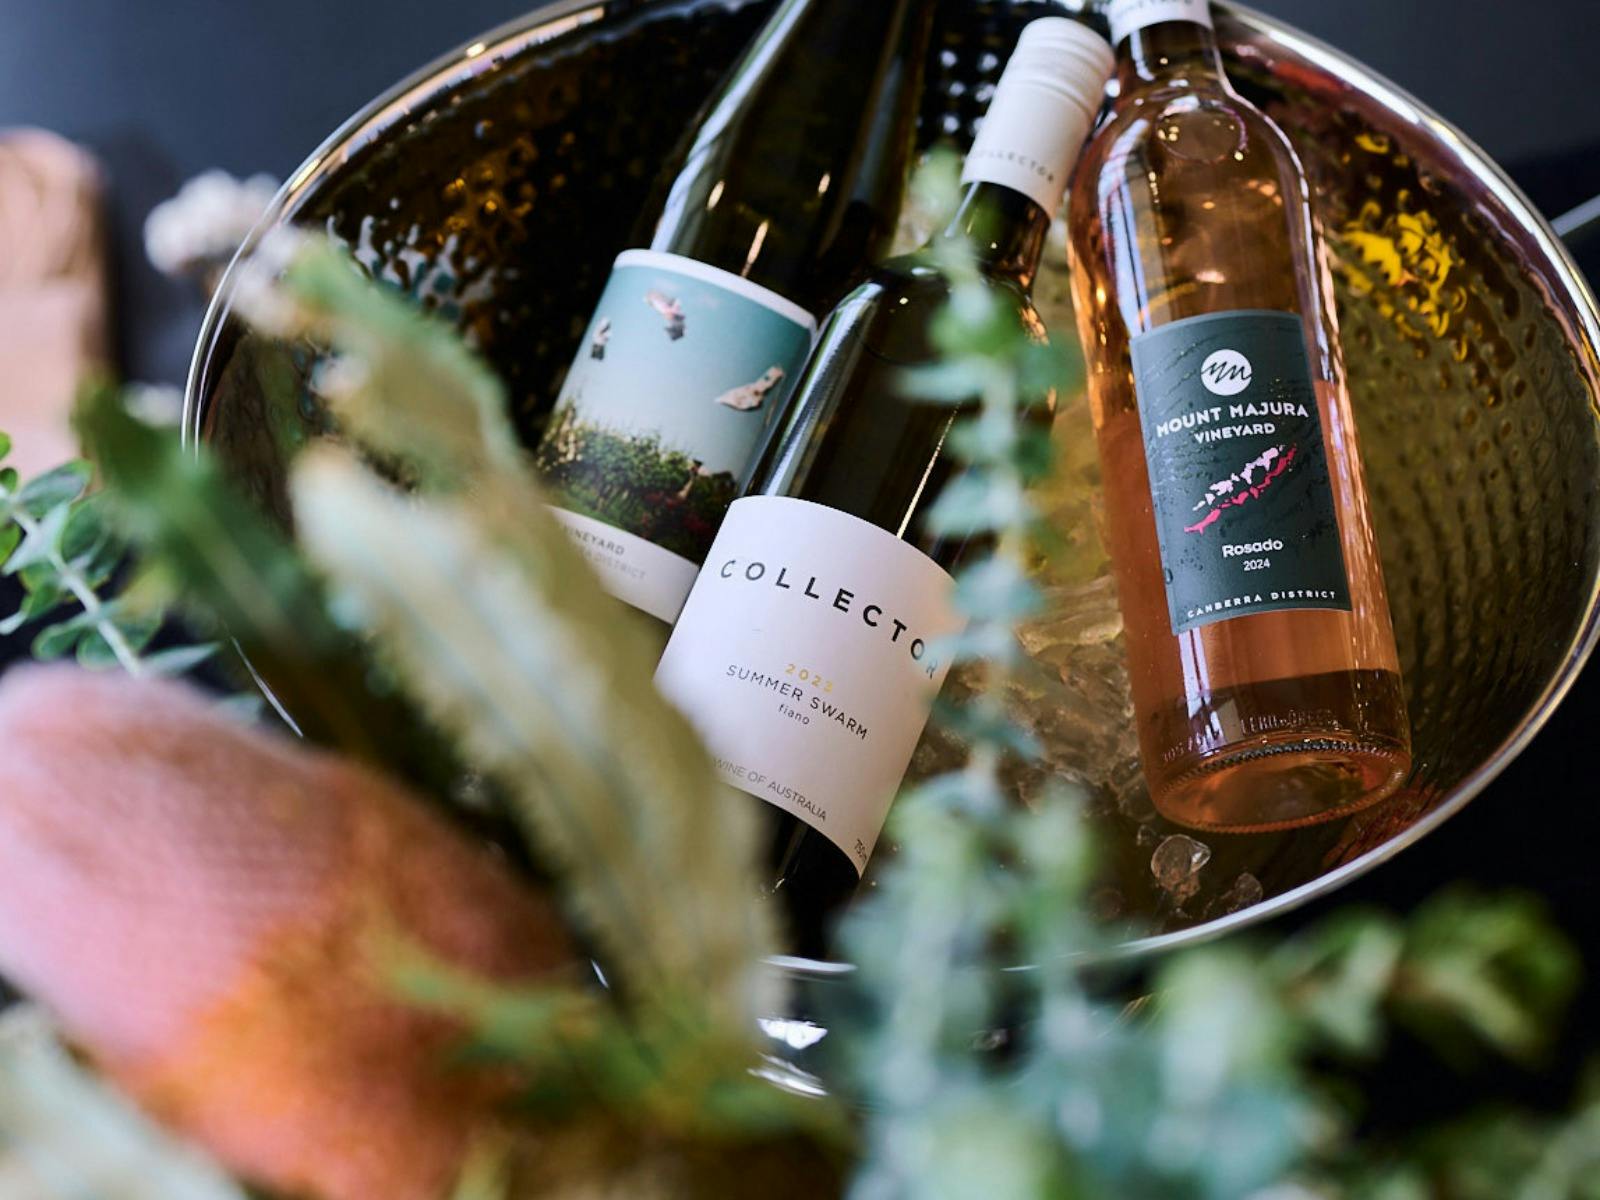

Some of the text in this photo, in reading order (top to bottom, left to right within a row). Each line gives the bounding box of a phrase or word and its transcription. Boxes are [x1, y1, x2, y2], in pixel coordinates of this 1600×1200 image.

[1156, 402, 1309, 437] MOUNT MAJURA
[1195, 423, 1276, 444] VINEYARD
[1222, 538, 1283, 558] Rosado
[1243, 557, 1270, 572] 2024
[1187, 590, 1336, 619] CANBERRA DISTRICT
[784, 663, 833, 694] 2023
[726, 664, 868, 740] SUMMER SWARM
[778, 703, 811, 726] fiano
[713, 758, 828, 823] WINE OF AUSTRALIA
